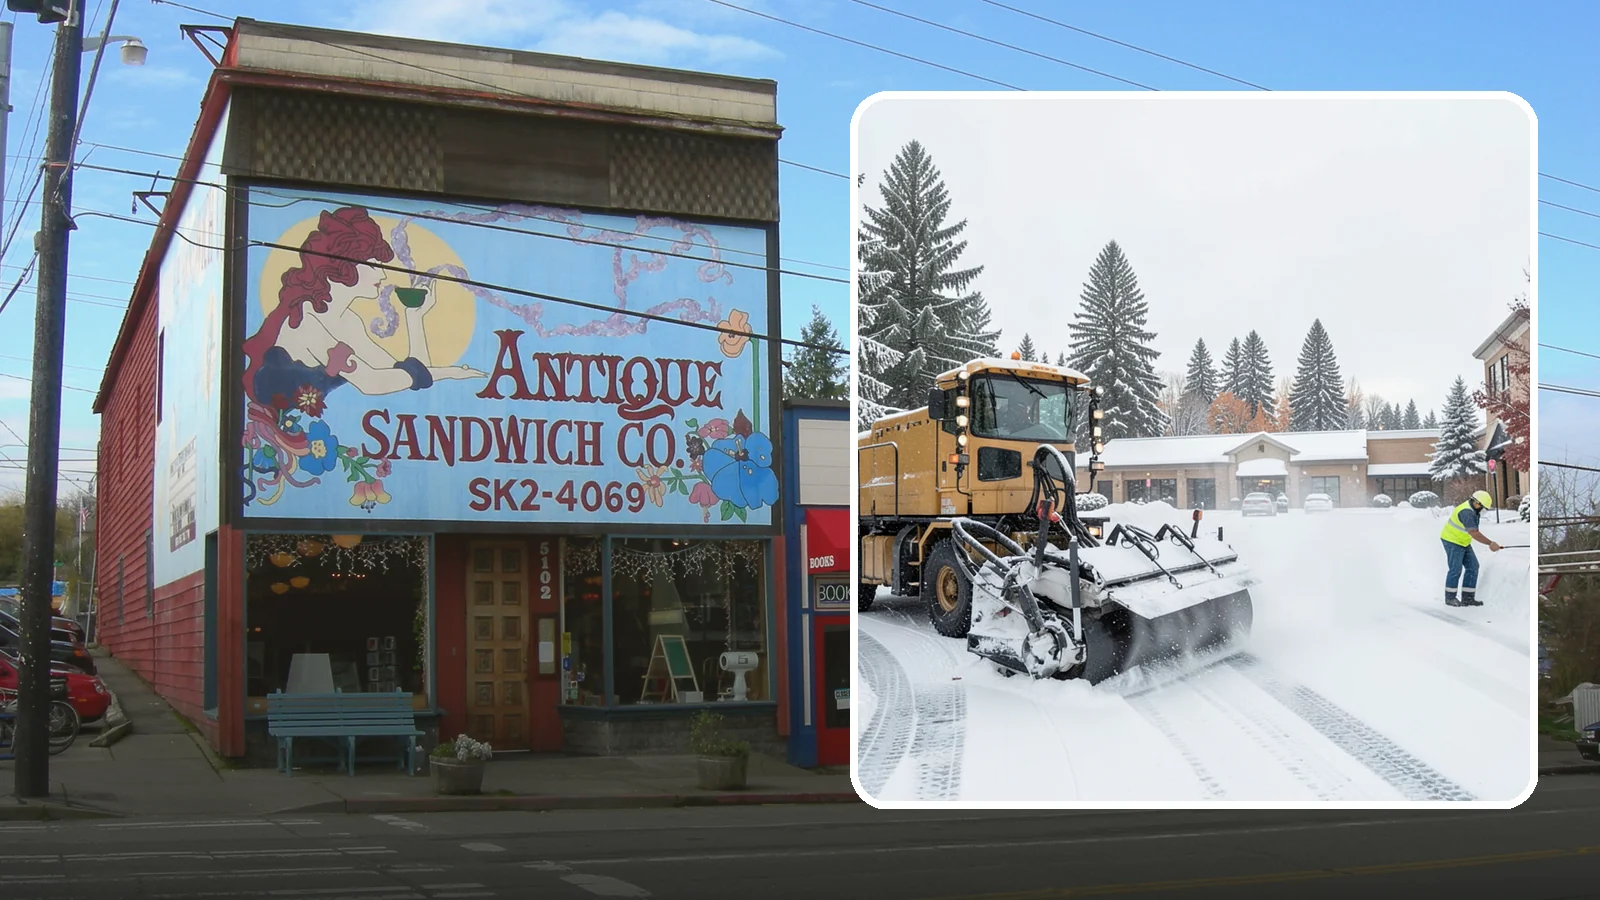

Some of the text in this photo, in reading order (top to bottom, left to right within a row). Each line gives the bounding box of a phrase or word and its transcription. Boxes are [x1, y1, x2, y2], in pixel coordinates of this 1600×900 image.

[476, 328, 724, 420] ANTIQUE
[361, 408, 686, 469] SANDWICH CO.
[468, 477, 647, 513] SK2-4069
[540, 541, 551, 600] 5102
[809, 555, 835, 569] BOOKS
